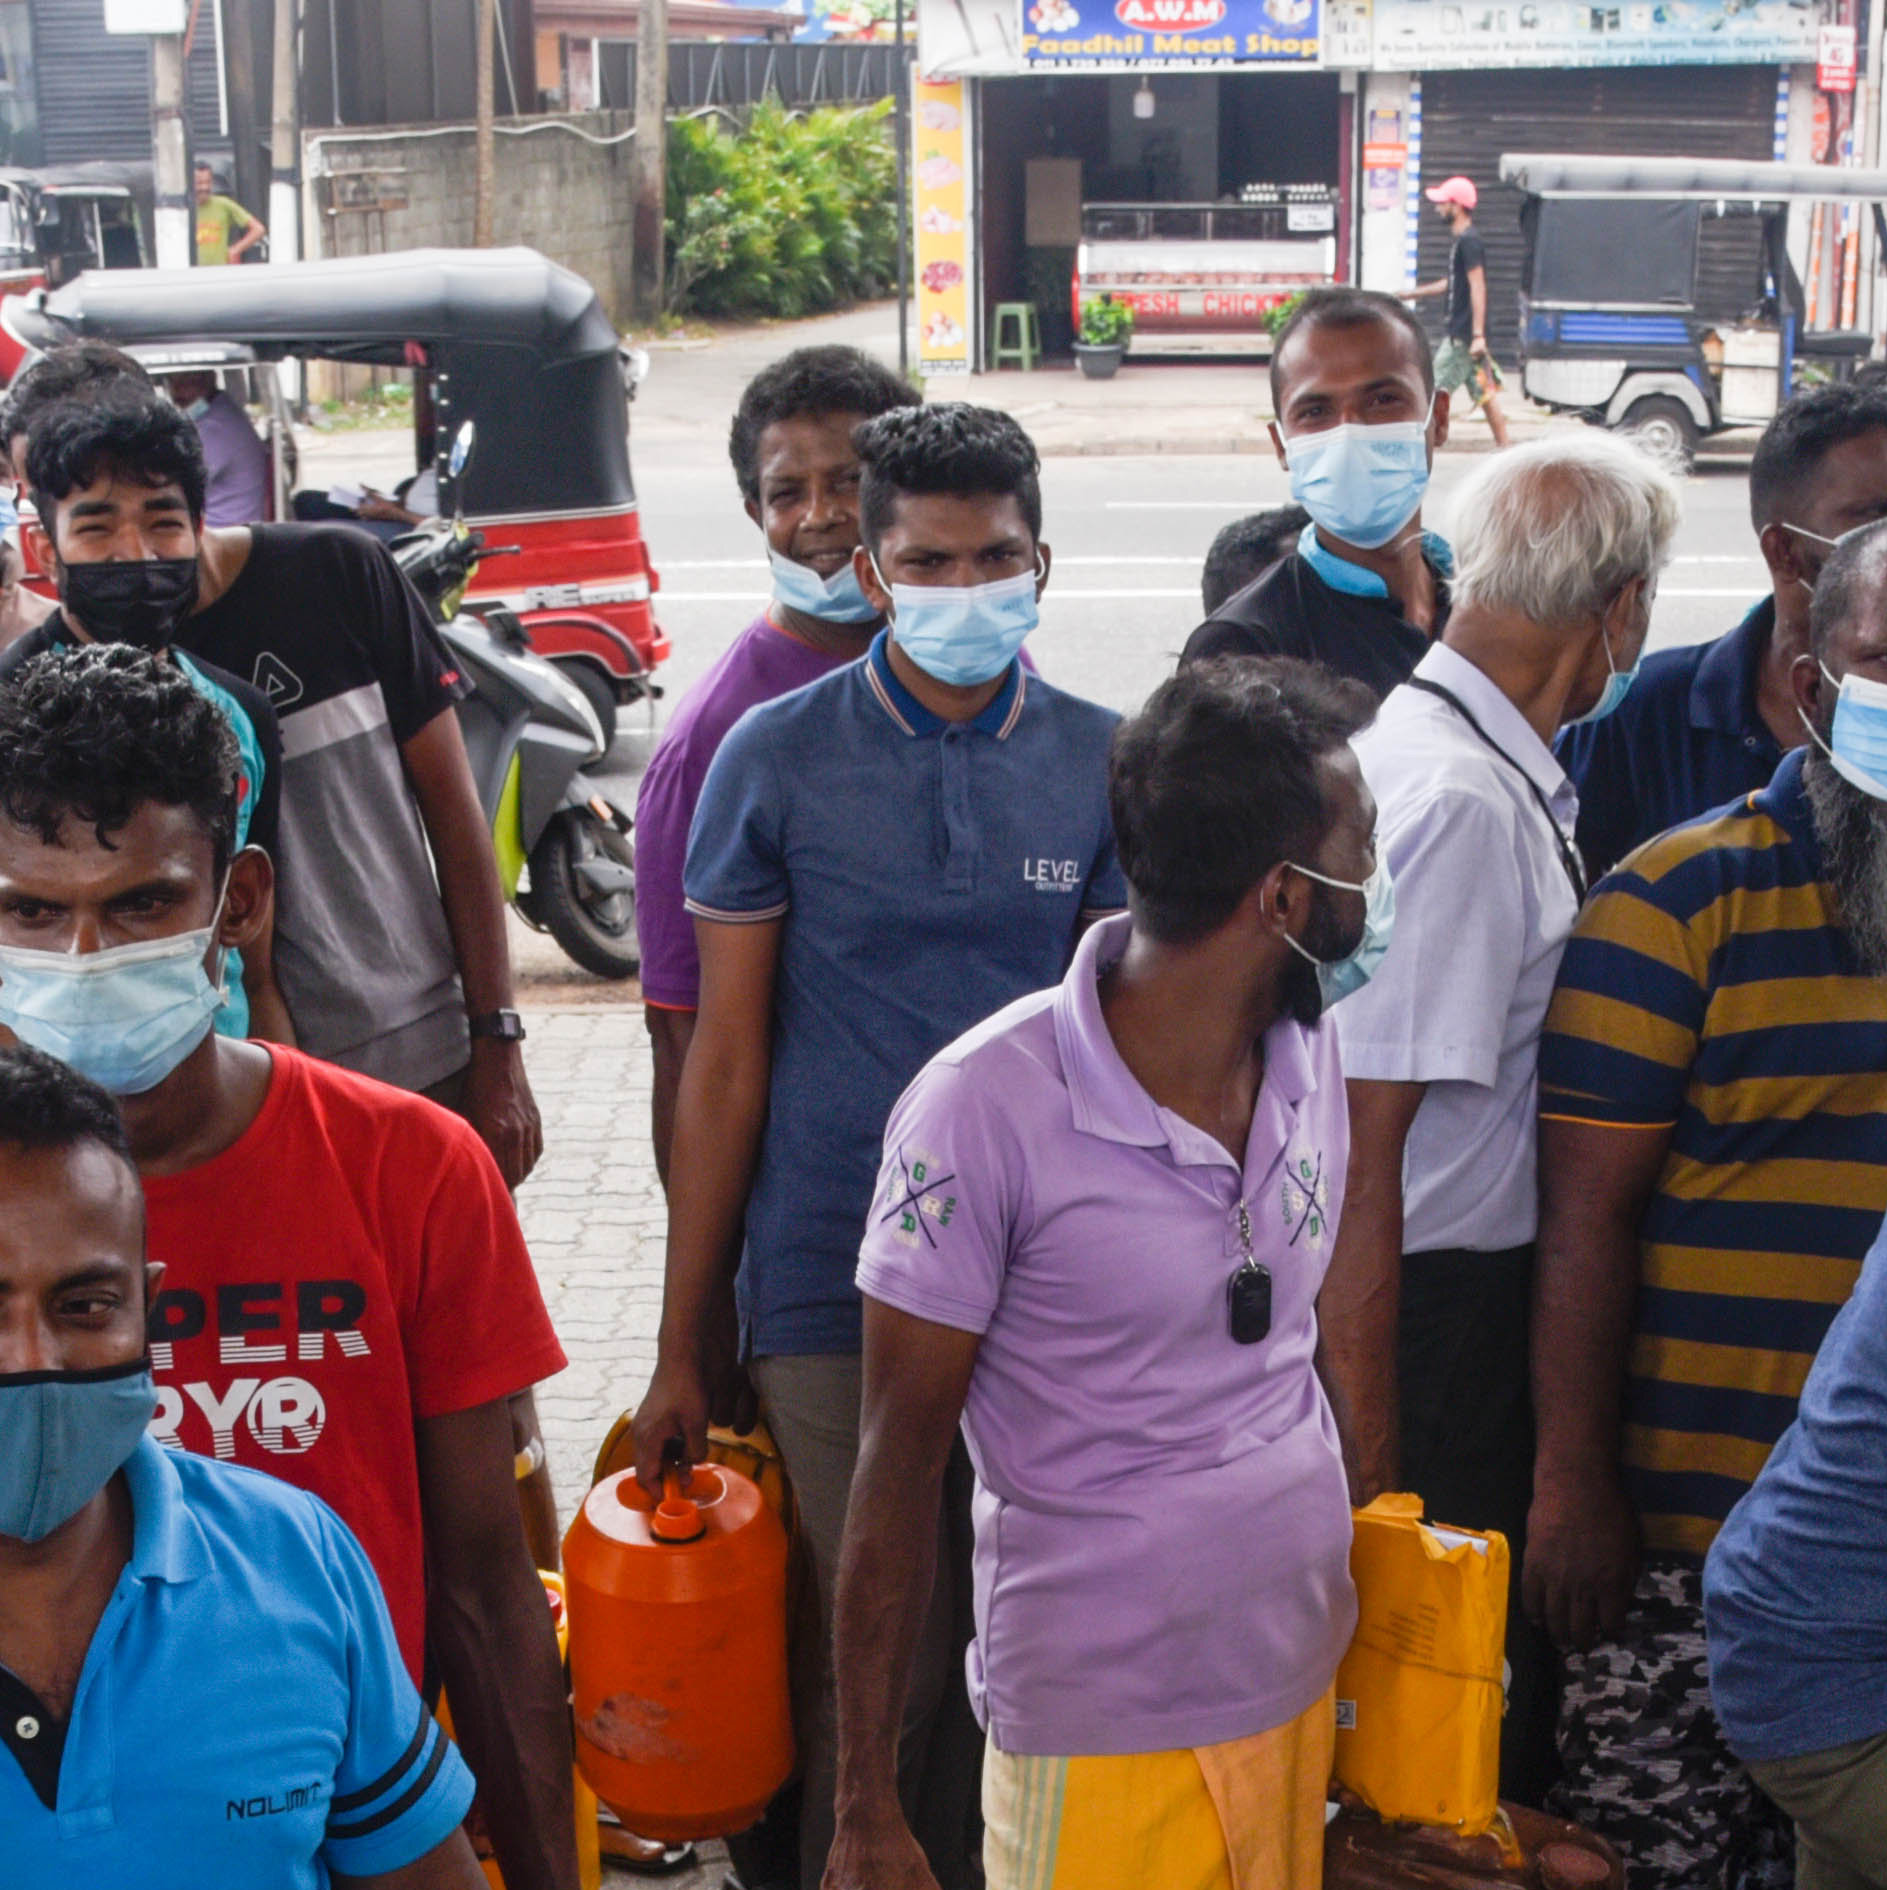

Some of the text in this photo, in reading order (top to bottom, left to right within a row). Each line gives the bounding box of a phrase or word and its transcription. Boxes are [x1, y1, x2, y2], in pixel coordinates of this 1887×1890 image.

[1023, 33, 1319, 58] Faadhil Meat Shop
[1024, 857, 1080, 883] LEVEL
